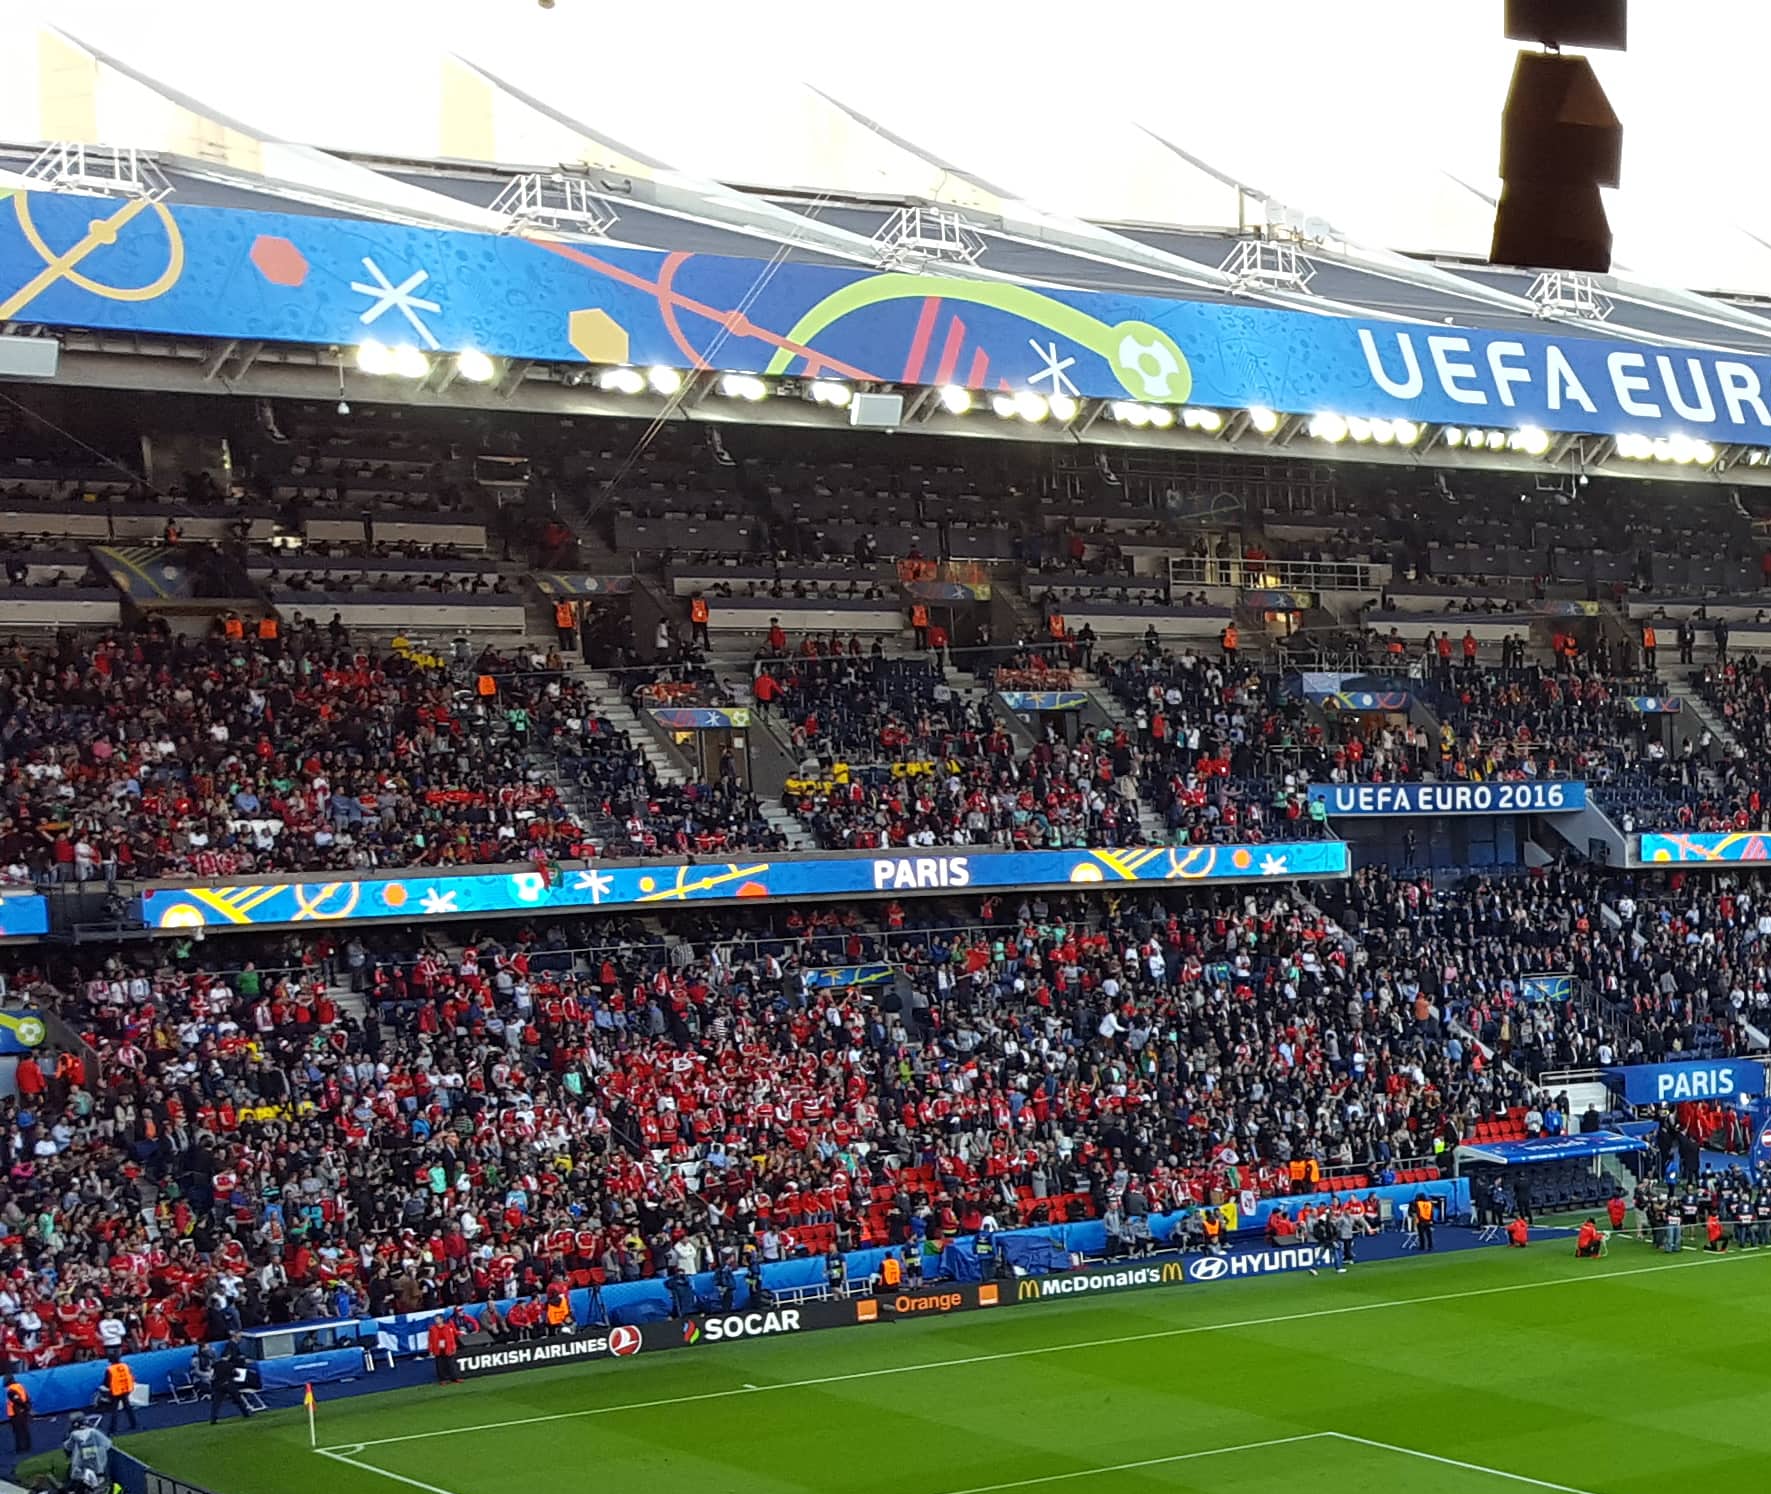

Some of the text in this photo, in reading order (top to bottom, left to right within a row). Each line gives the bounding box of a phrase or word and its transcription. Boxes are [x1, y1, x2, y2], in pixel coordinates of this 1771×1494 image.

[1357, 329, 1597, 413] UEFA
[1336, 785, 1564, 811] UEFA EURO 2016
[874, 857, 970, 889] PARIS
[1658, 1068, 1734, 1099] PARIS
[1042, 1266, 1160, 1297] McDonald's
[895, 1292, 962, 1313] Orange
[703, 1310, 800, 1340] SOCAR
[456, 1337, 608, 1372] TURKISH AIRLINES
